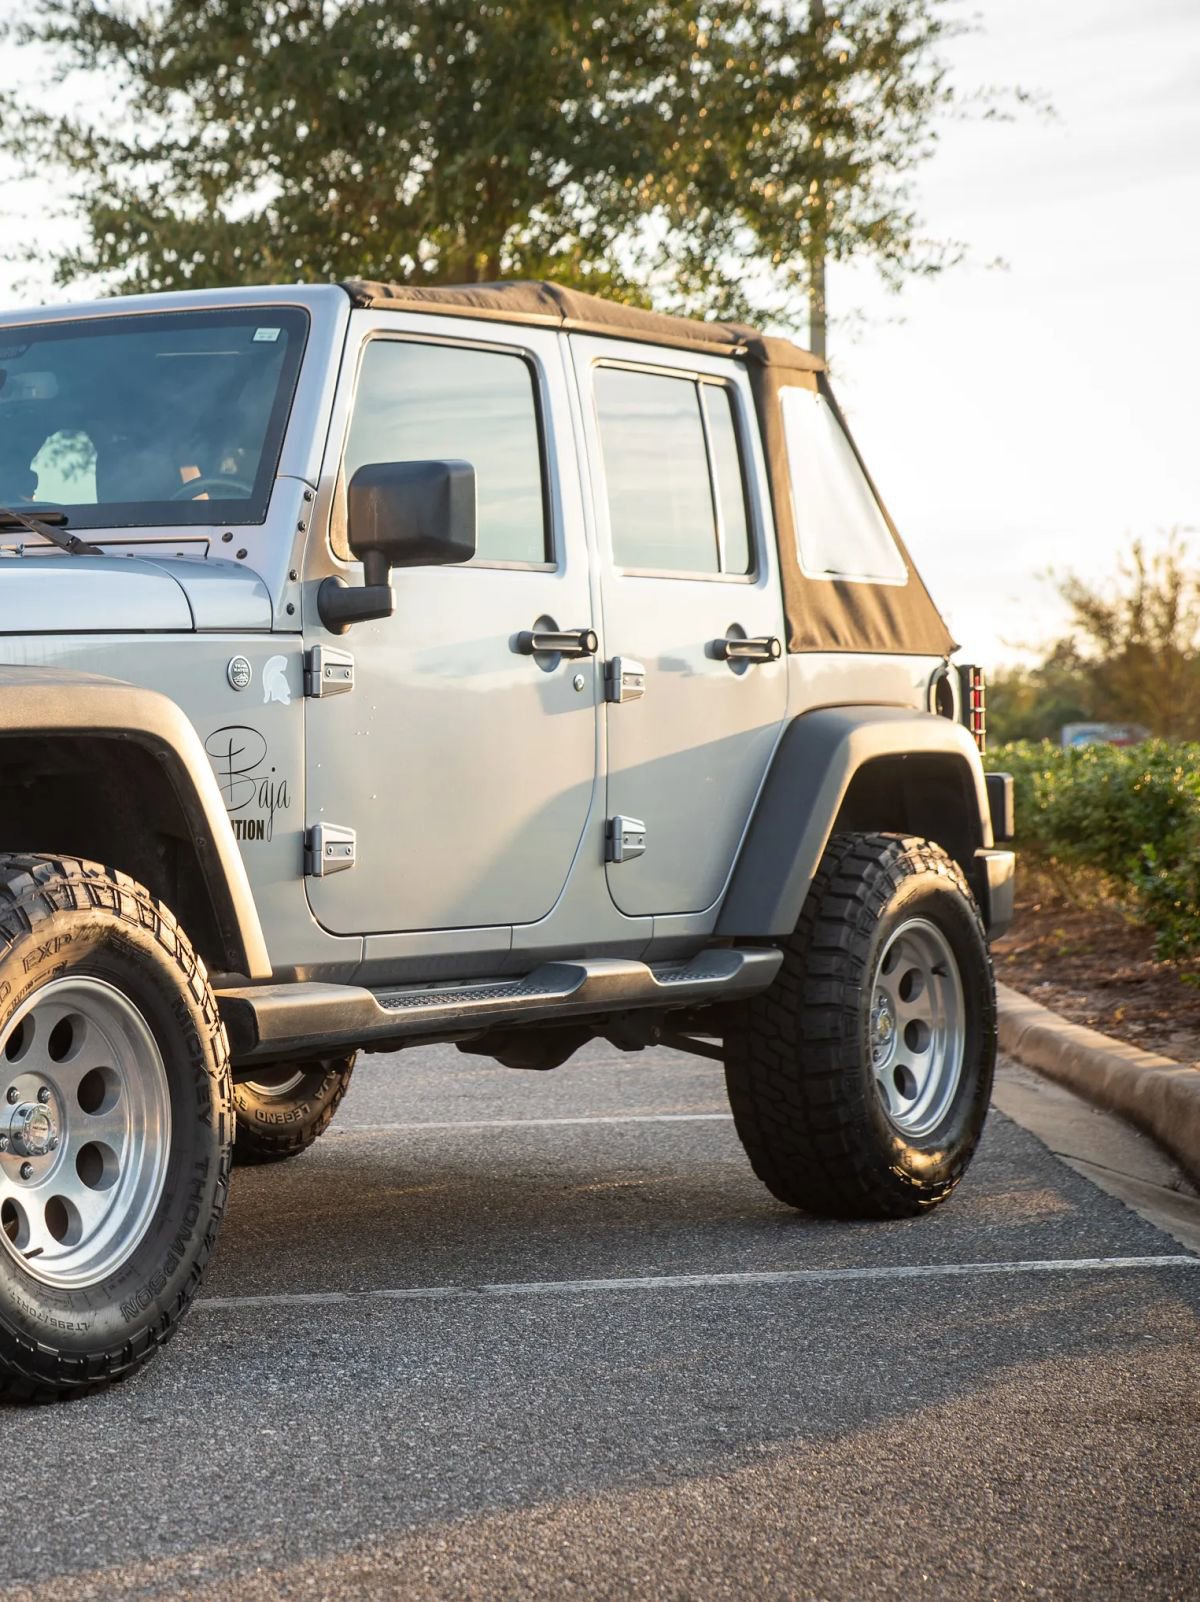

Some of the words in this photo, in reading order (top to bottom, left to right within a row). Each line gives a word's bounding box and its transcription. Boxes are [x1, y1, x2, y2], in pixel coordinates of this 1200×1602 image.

[205, 725, 290, 842] Baja
[23, 933, 73, 974] EXP
[256, 1104, 311, 1124] LEGEND
[120, 1155, 210, 1323] THOMPSON
